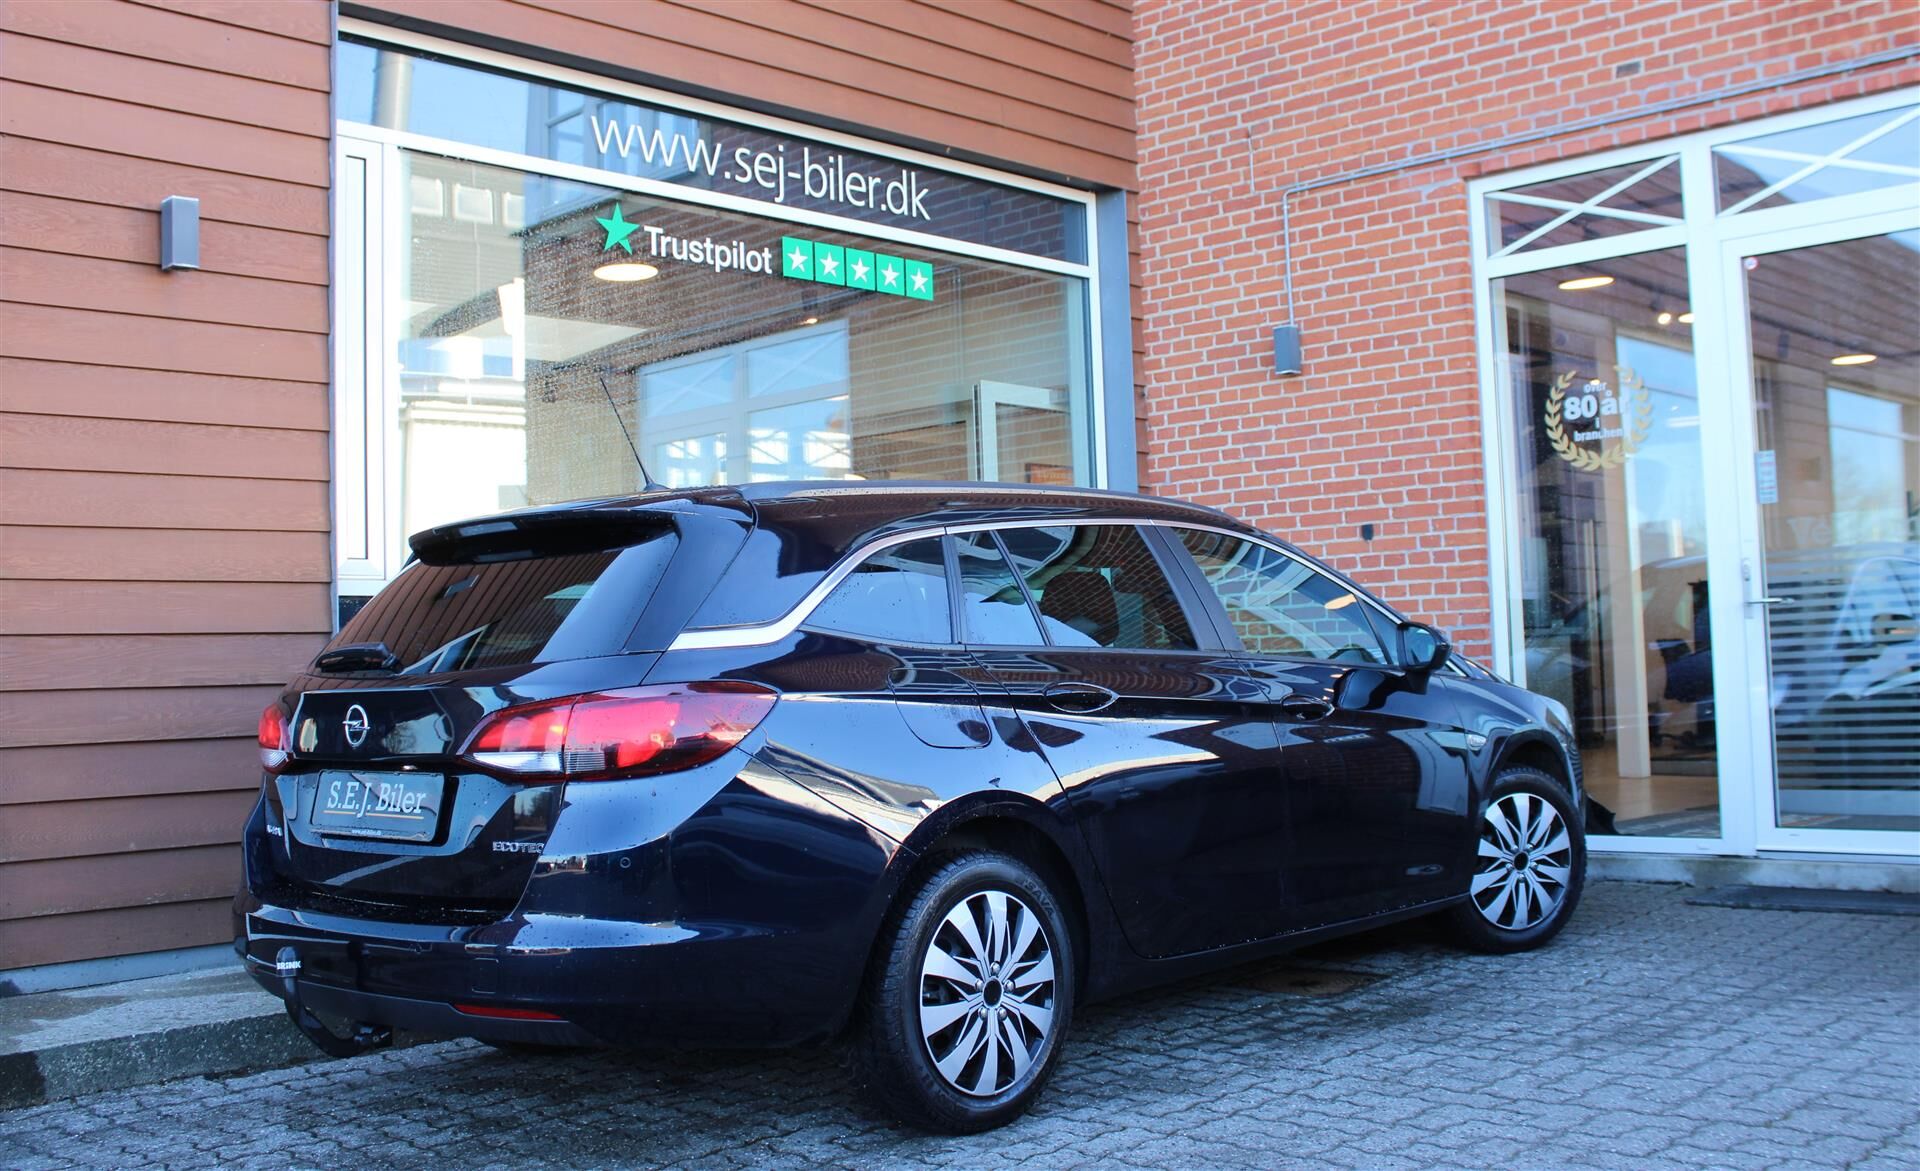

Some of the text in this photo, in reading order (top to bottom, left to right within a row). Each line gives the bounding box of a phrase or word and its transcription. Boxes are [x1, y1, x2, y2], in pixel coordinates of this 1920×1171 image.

[591, 115, 931, 220] www.sej-biler.dk
[643, 225, 773, 275] Trustpilot
[1563, 394, 1598, 420] 80
[1573, 428, 1624, 442] branchen
[327, 780, 427, 818] S.E.J. Biler
